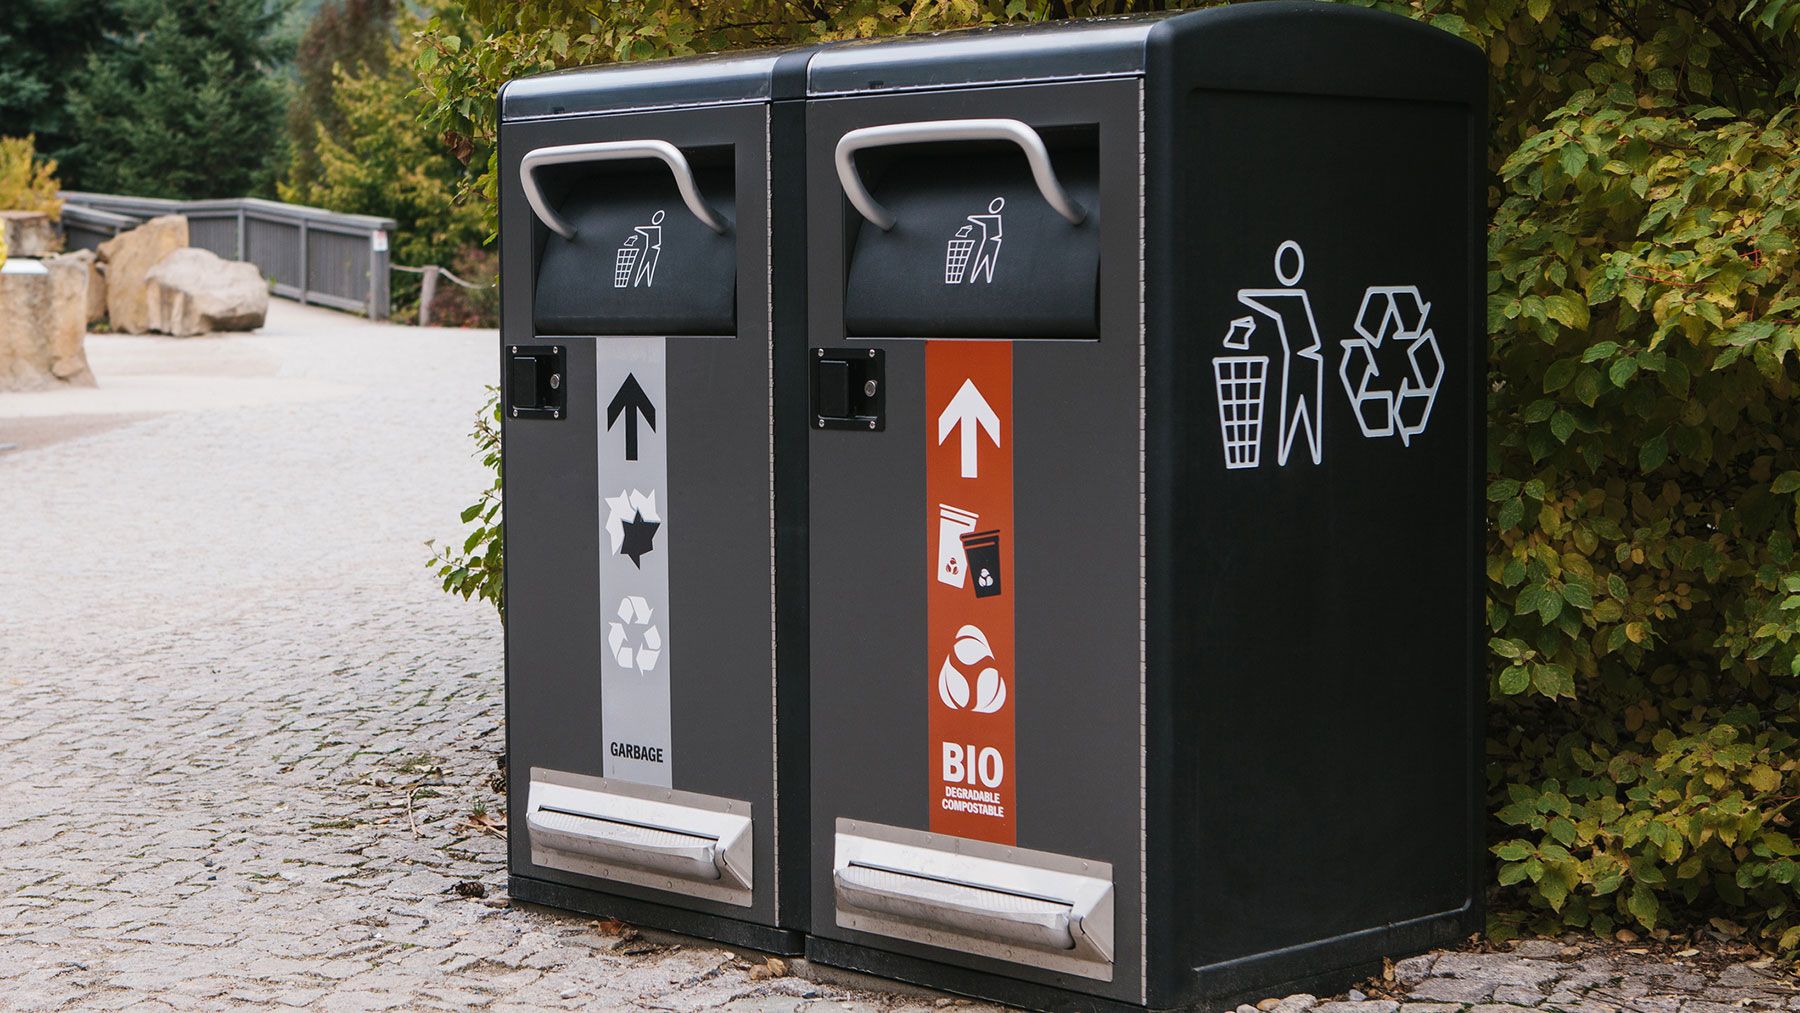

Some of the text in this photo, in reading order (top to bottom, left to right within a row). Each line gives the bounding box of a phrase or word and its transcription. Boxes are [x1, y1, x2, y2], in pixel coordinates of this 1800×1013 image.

[610, 741, 664, 763] GARBAGE
[942, 741, 1004, 789] BIO
[945, 786, 1000, 804] DEGRADABLE
[941, 798, 1004, 818] COMPOSTABLE
